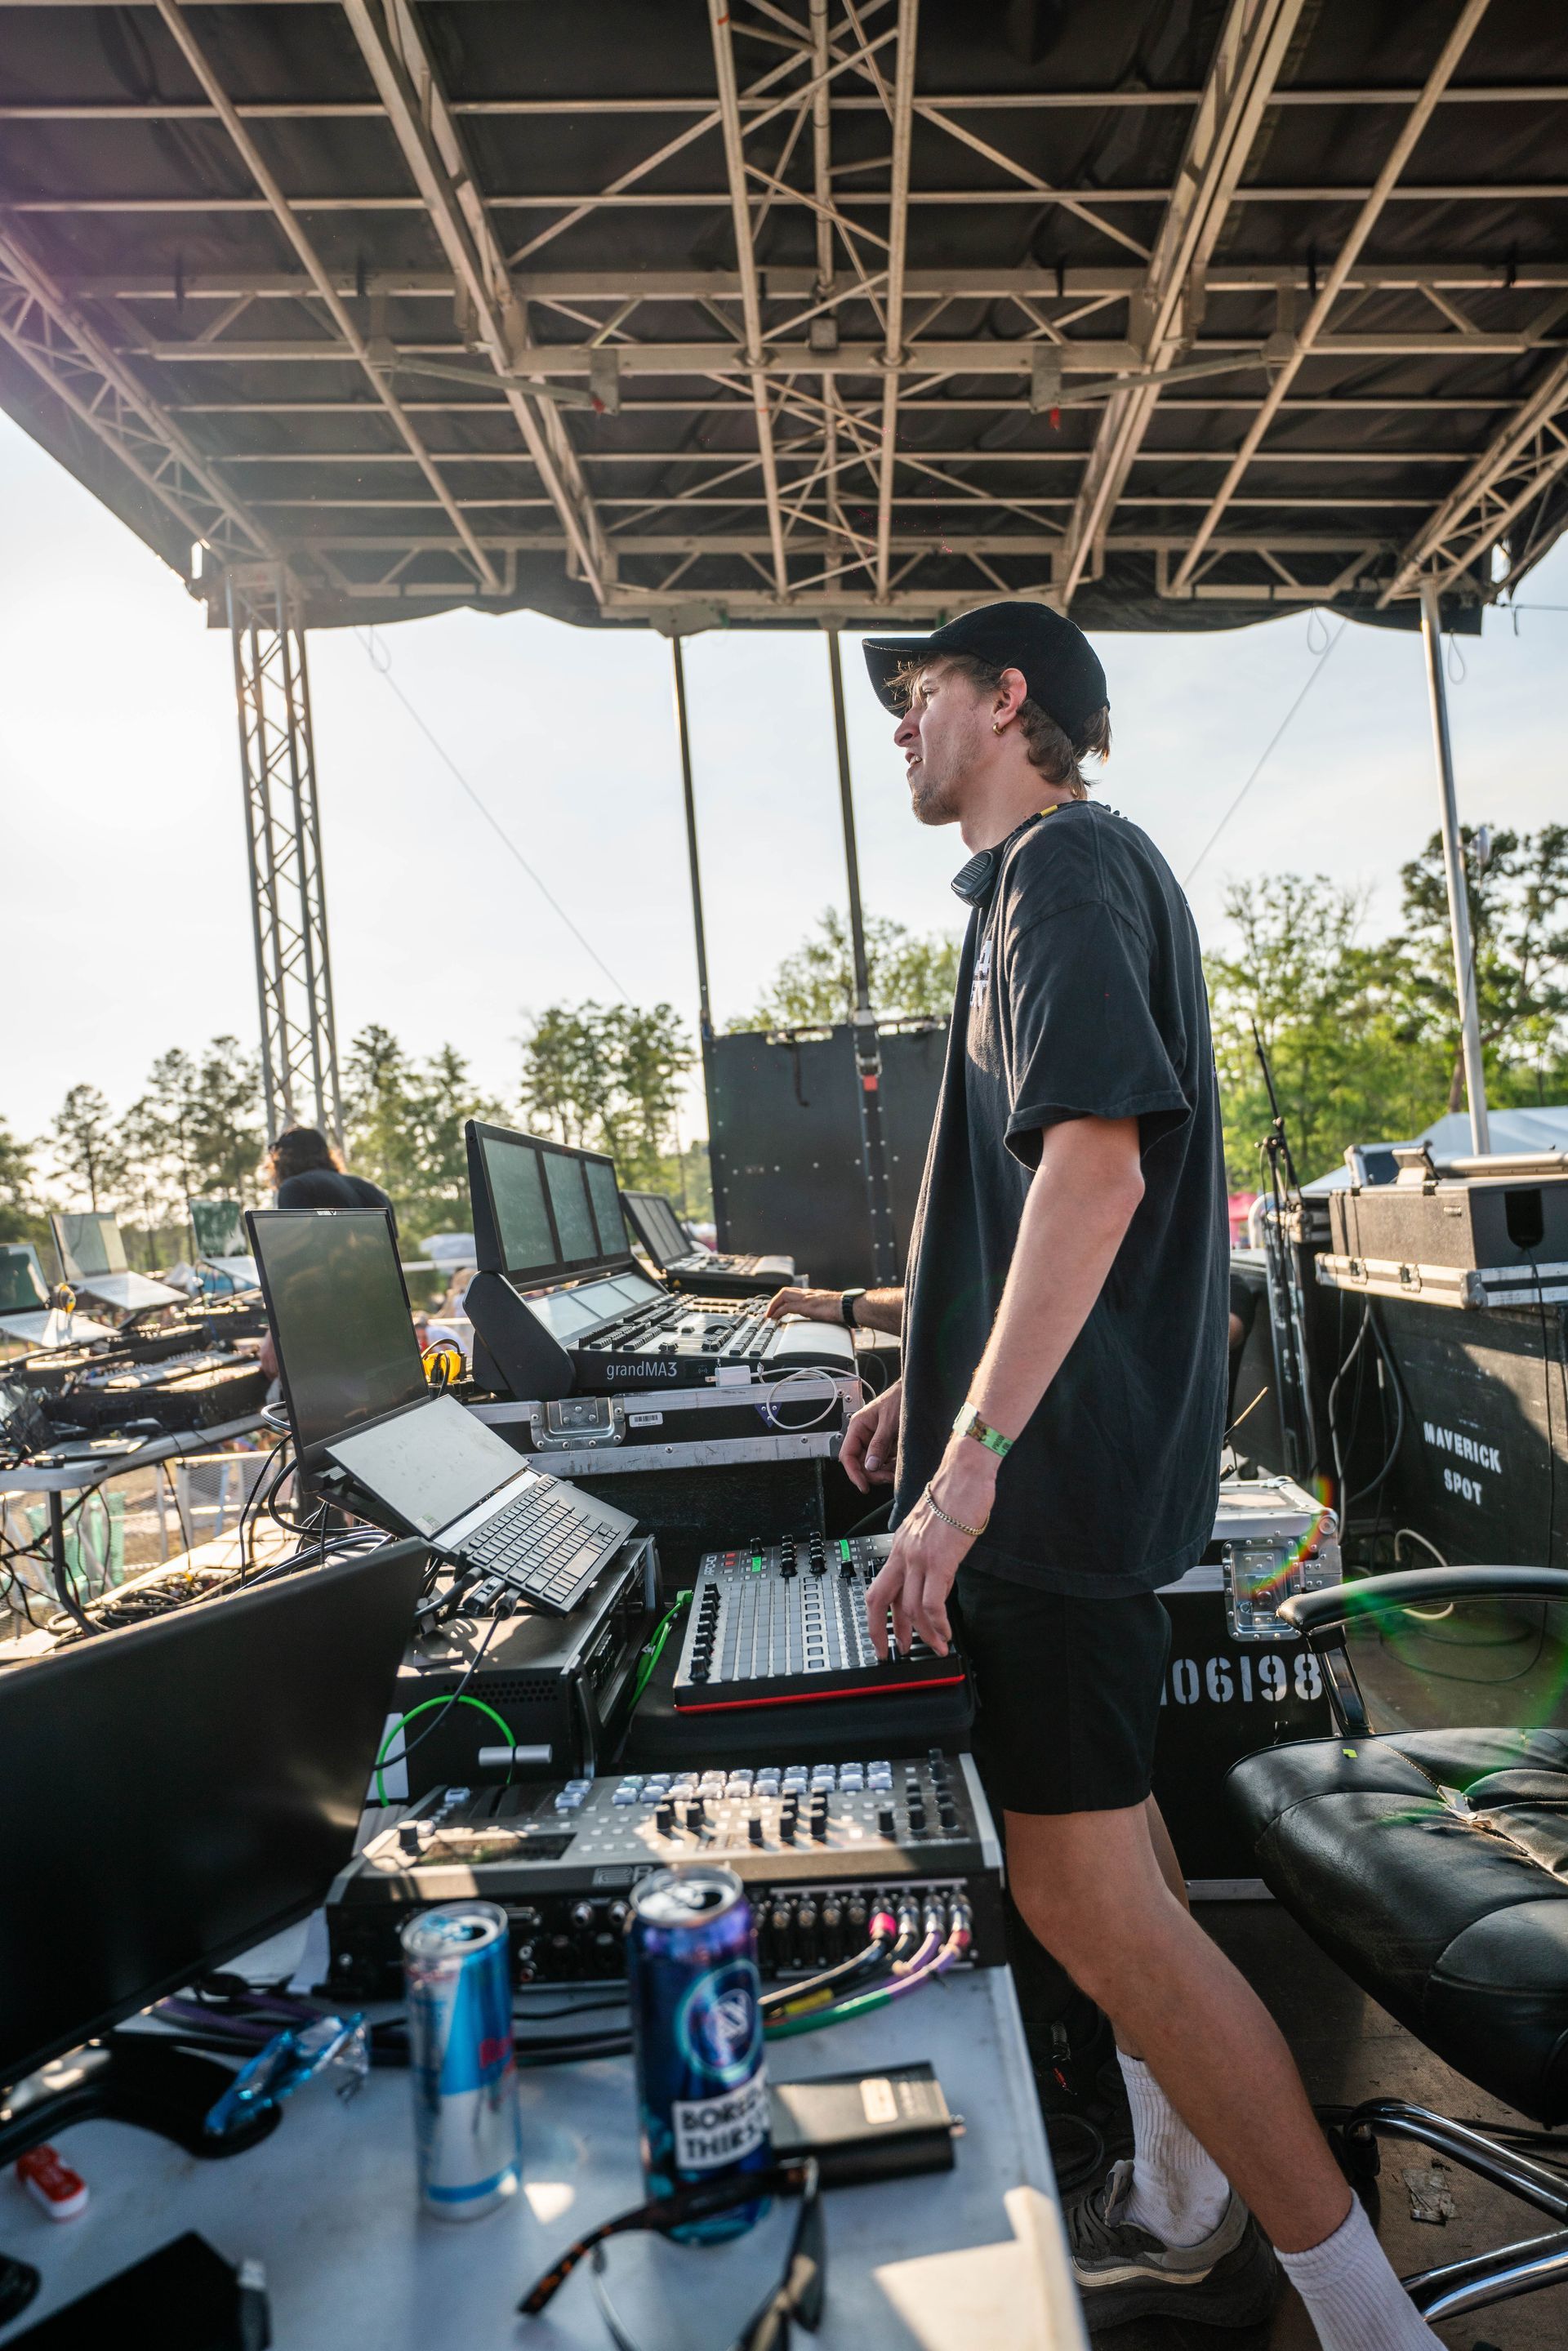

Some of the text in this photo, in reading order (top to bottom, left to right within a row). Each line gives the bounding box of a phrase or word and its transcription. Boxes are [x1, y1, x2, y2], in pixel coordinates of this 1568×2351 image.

[607, 1360, 677, 1380] grandMA3
[1423, 1421, 1502, 1474] MAVERICK
[1443, 1467, 1482, 1506] SPOT
[1160, 1653, 1322, 1707] 06198
